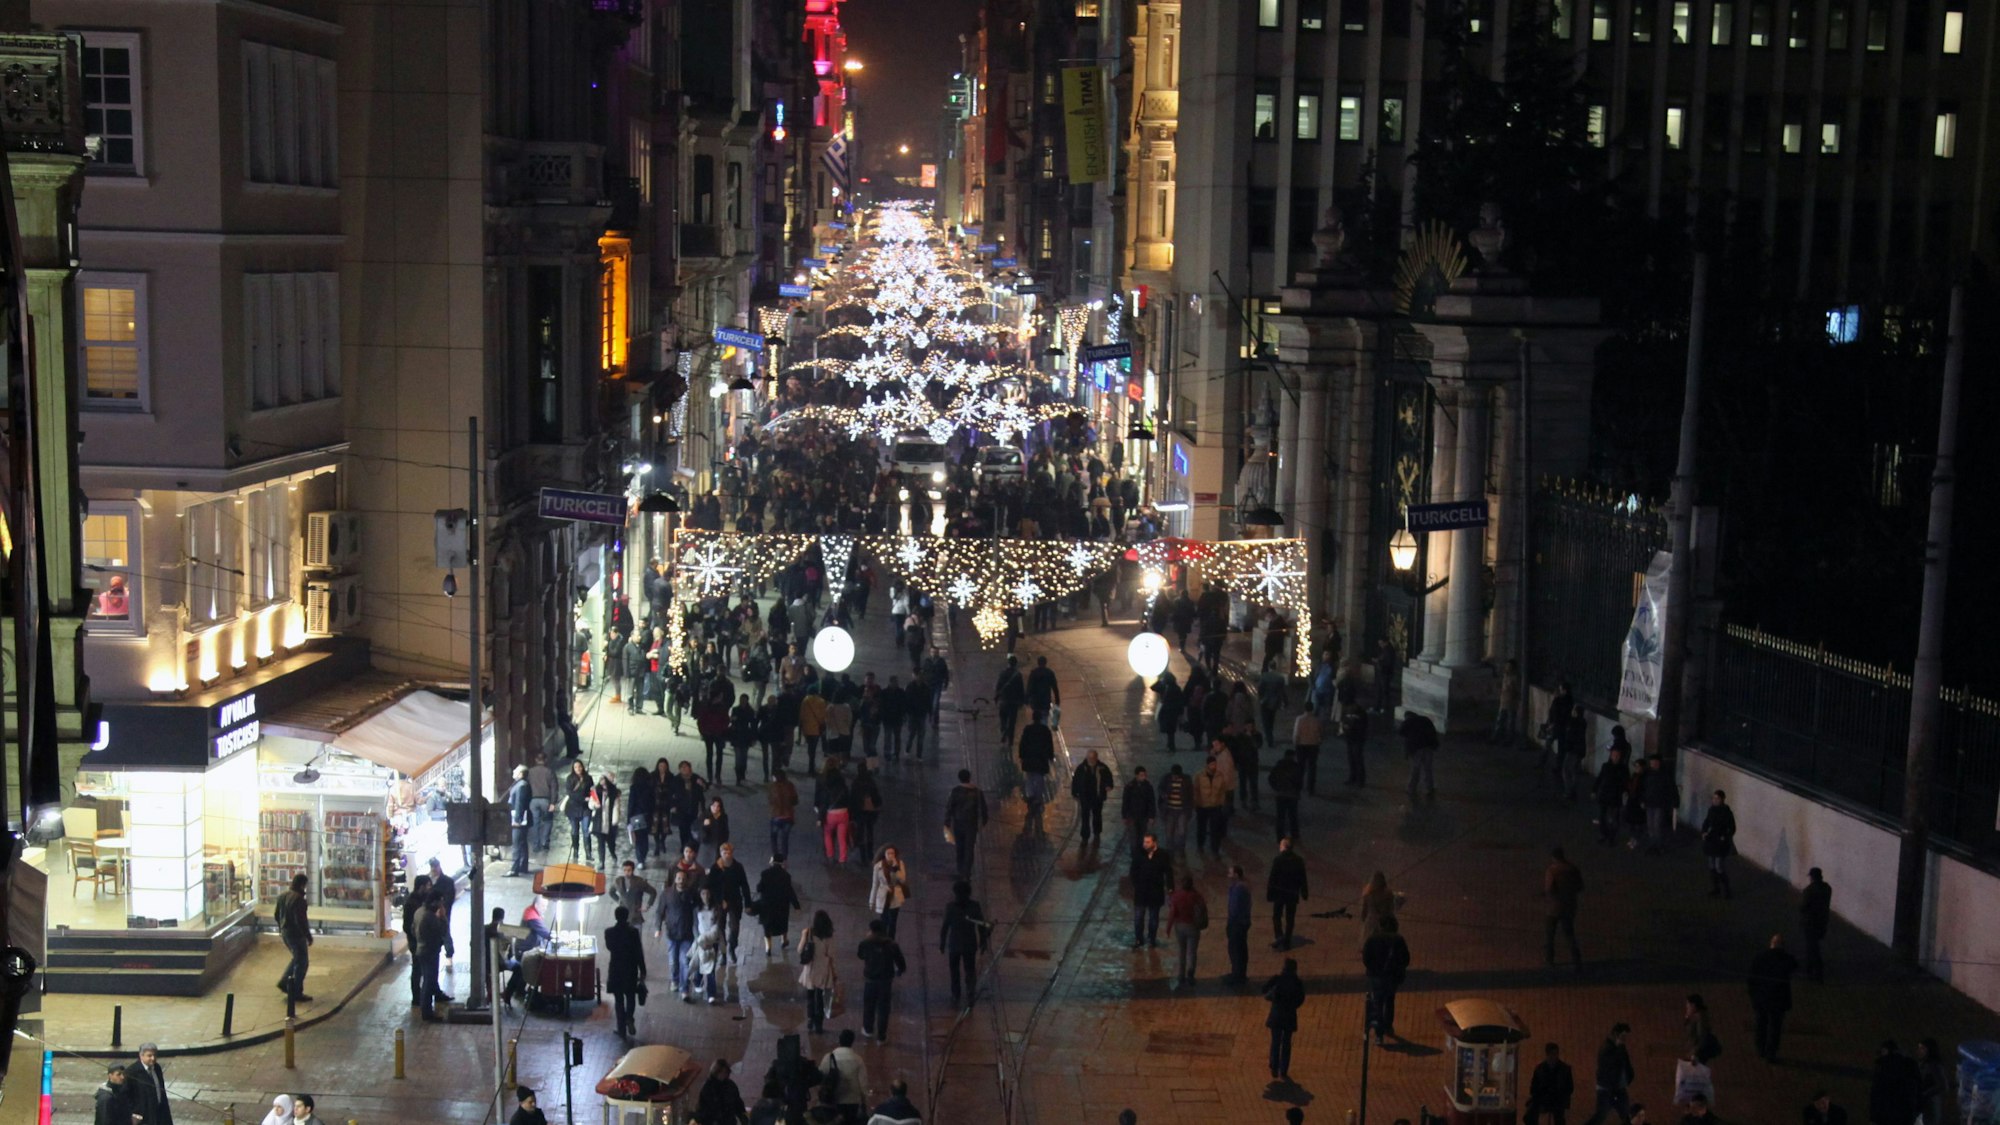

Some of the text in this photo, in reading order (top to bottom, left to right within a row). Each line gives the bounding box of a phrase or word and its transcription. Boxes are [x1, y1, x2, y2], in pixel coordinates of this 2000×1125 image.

[1080, 71, 1098, 176] ENGLISH TIME
[717, 331, 761, 348] TURKCELL
[543, 495, 625, 517] TURKCELL
[1409, 507, 1486, 525] TURKCELL
[220, 693, 256, 729] AYVALIK
